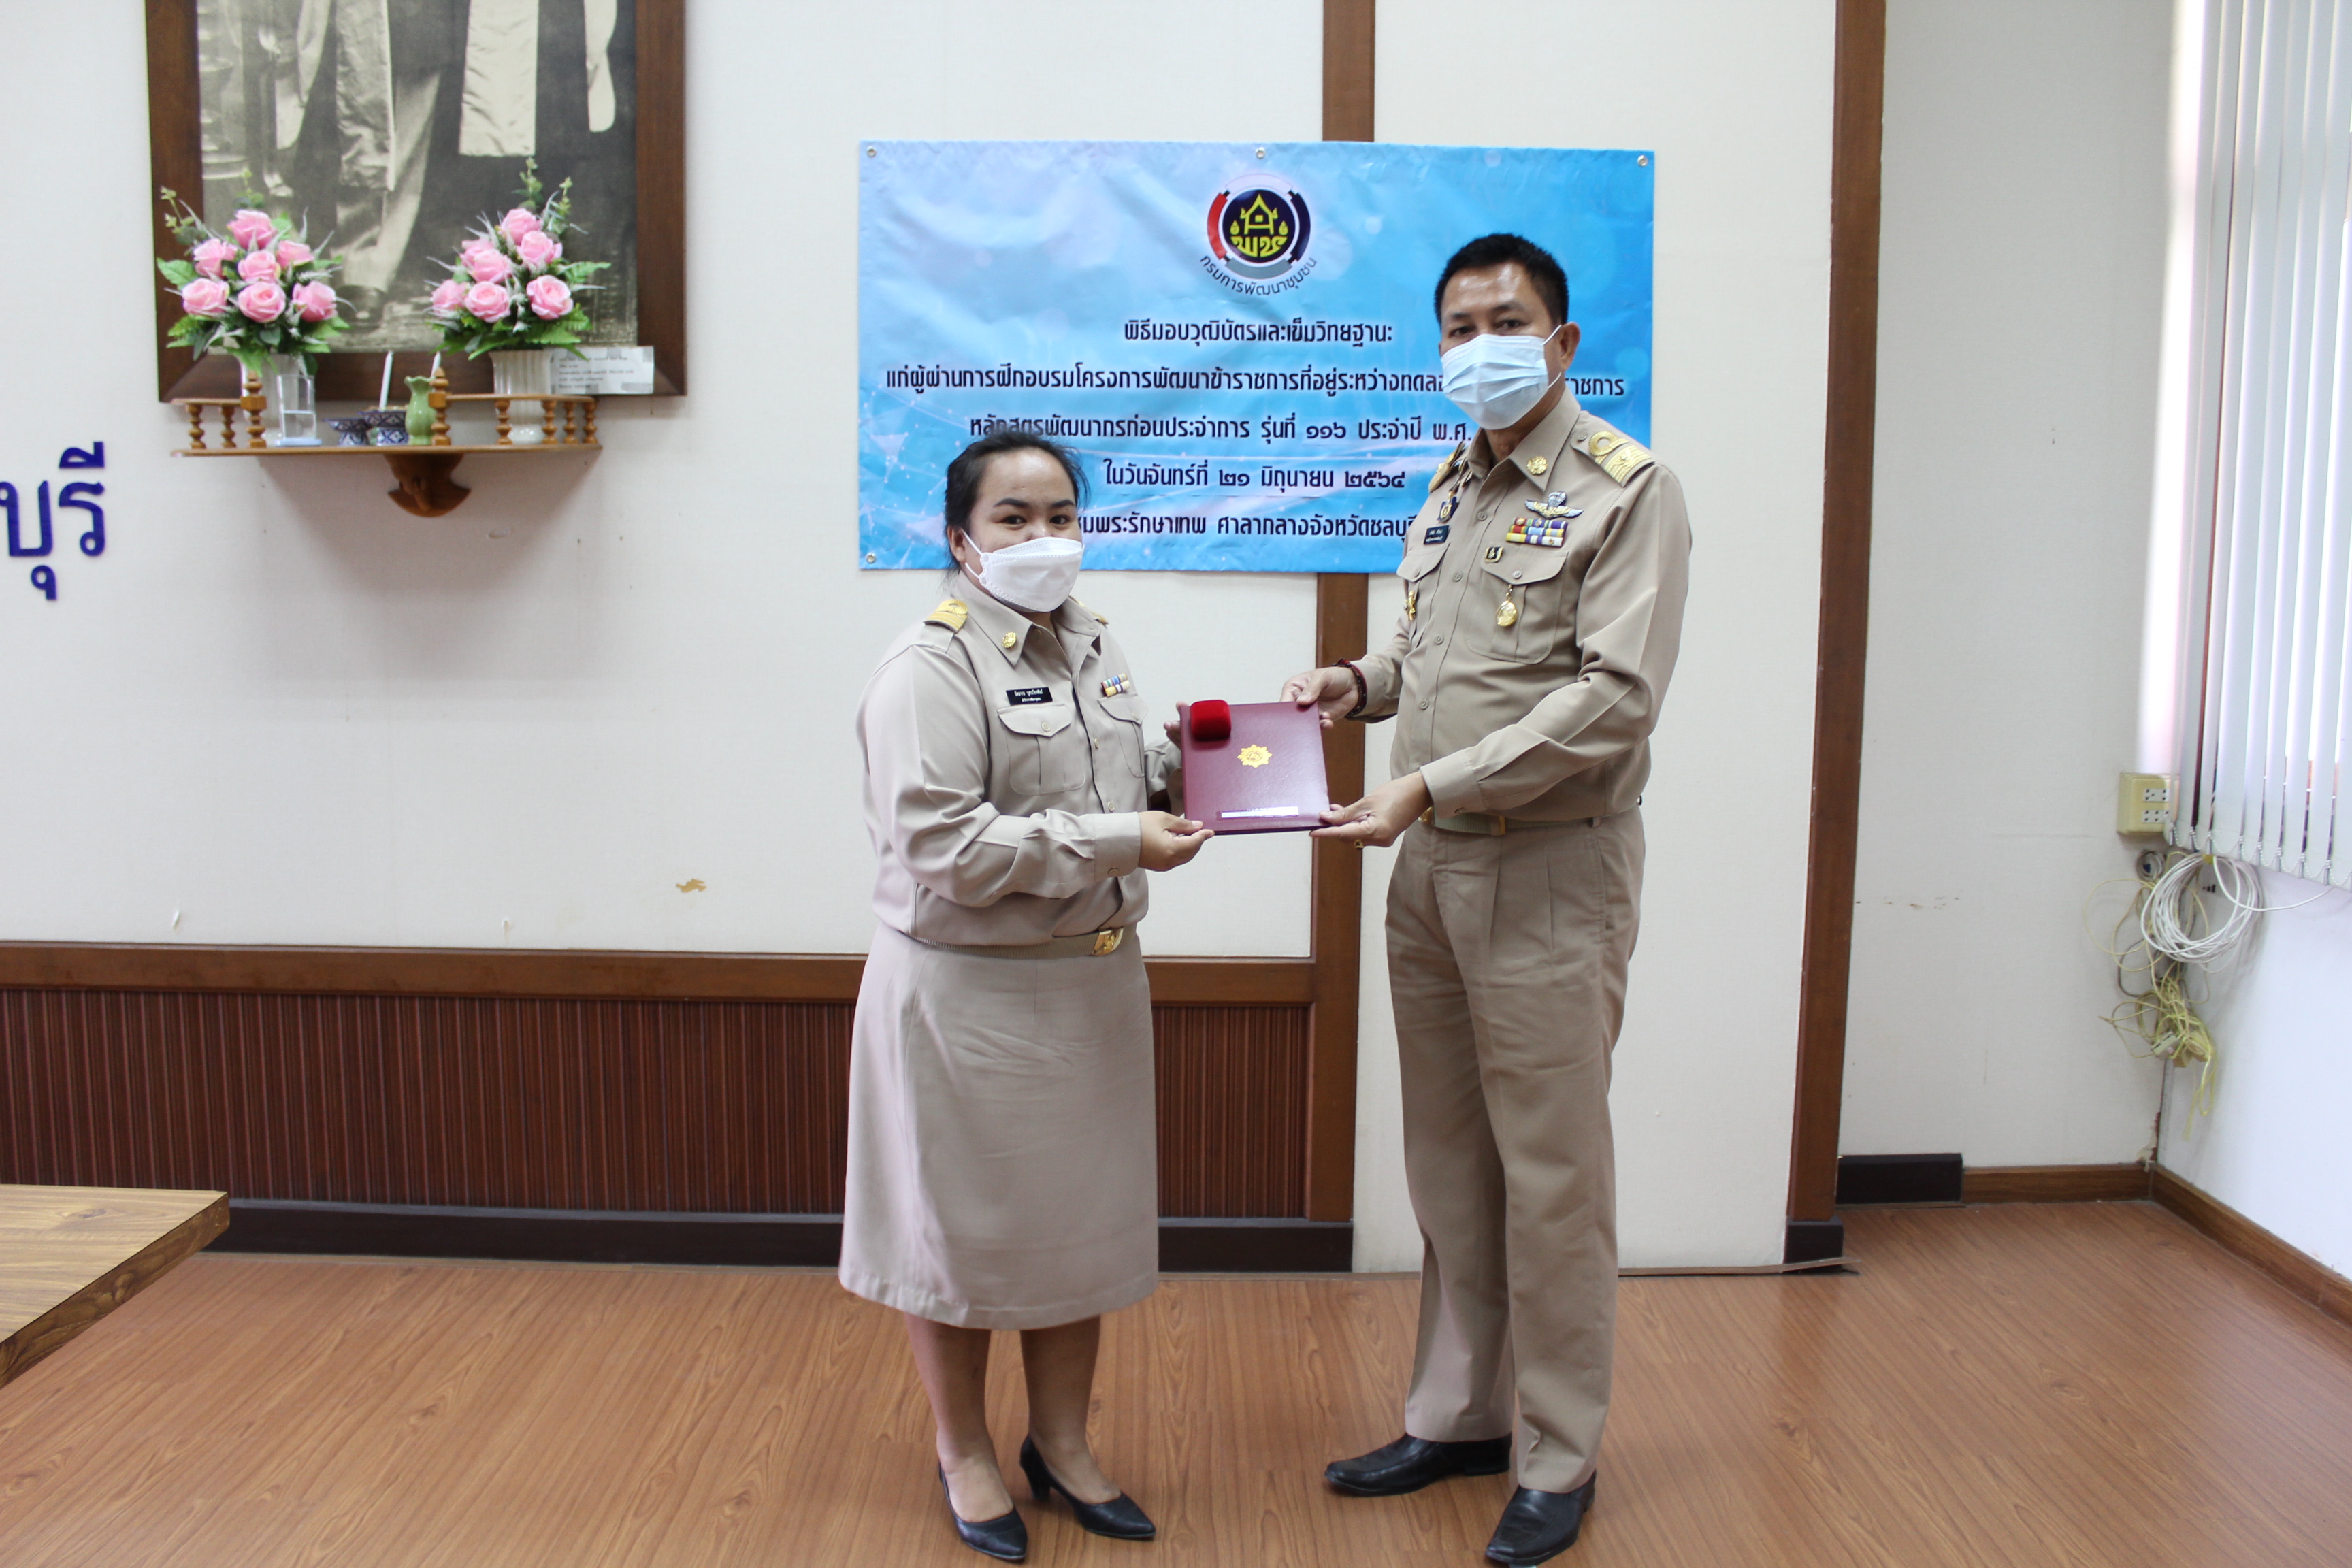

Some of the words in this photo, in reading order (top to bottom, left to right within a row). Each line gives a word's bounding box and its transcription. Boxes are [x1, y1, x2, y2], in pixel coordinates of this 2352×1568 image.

[1200, 254, 1317, 296] กรมการพัฒนาชุมชน
[1124, 317, 1392, 347] พิธีมอบวุฒิบัตรและเข็มวิทยฐานะ
[1565, 378, 1624, 396] าชการ
[970, 414, 1250, 438] หลักสตรพัฒนากรก่อนประจำการ
[1261, 412, 1296, 444] รุ่นที่
[1306, 421, 1346, 439] ๑๑๖
[1358, 416, 1422, 440] ประจำปี
[1433, 423, 1471, 441] พ.ศ.
[1102, 458, 1208, 487] ในวันจันทร์ที่
[1219, 469, 1250, 486] ๒๑
[1261, 466, 1334, 493] มิถุนายน
[1345, 470, 1406, 488] ๒๕๖๔
[1079, 512, 1207, 534] มพระรักษาเทพ
